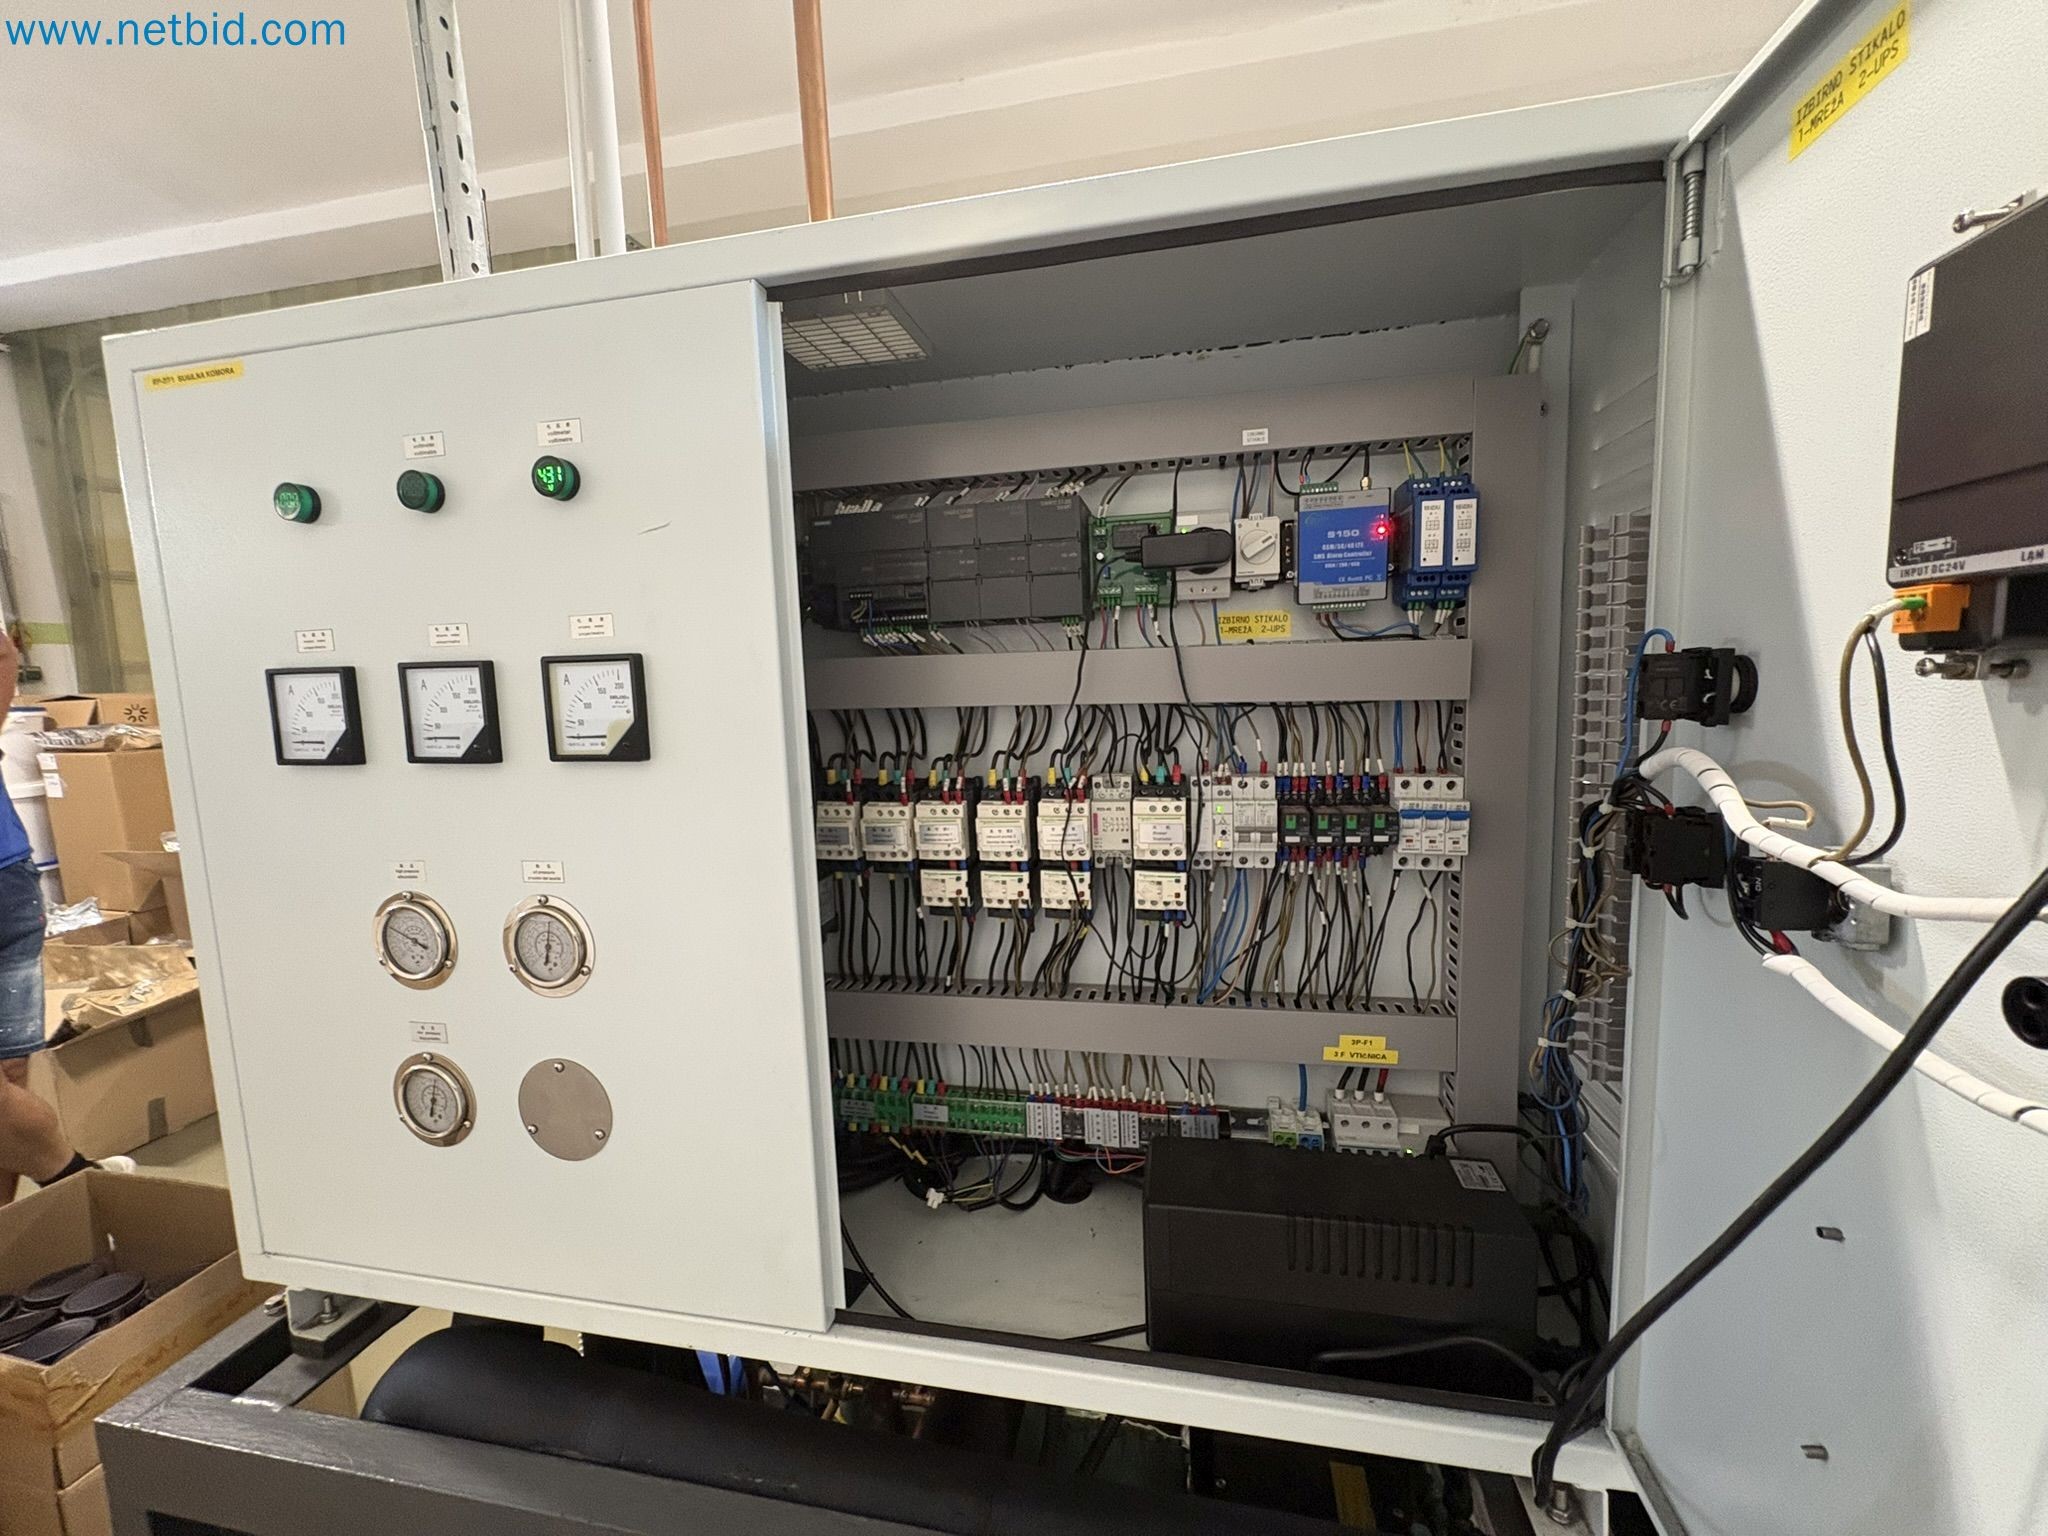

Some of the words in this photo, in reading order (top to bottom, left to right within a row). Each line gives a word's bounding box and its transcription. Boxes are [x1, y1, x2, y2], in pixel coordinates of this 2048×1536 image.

[1796, 69, 1843, 126] IZBIRNO
[1848, 9, 1906, 76] STIKALO
[1858, 38, 1899, 89] 2-UPS
[1900, 565, 1930, 578] INPUT
[1931, 560, 1966, 574] DC24V
[1218, 615, 1250, 625] IZBIRNO
[1254, 614, 1289, 624] STIKALO
[1260, 624, 1286, 633] 2-UPS
